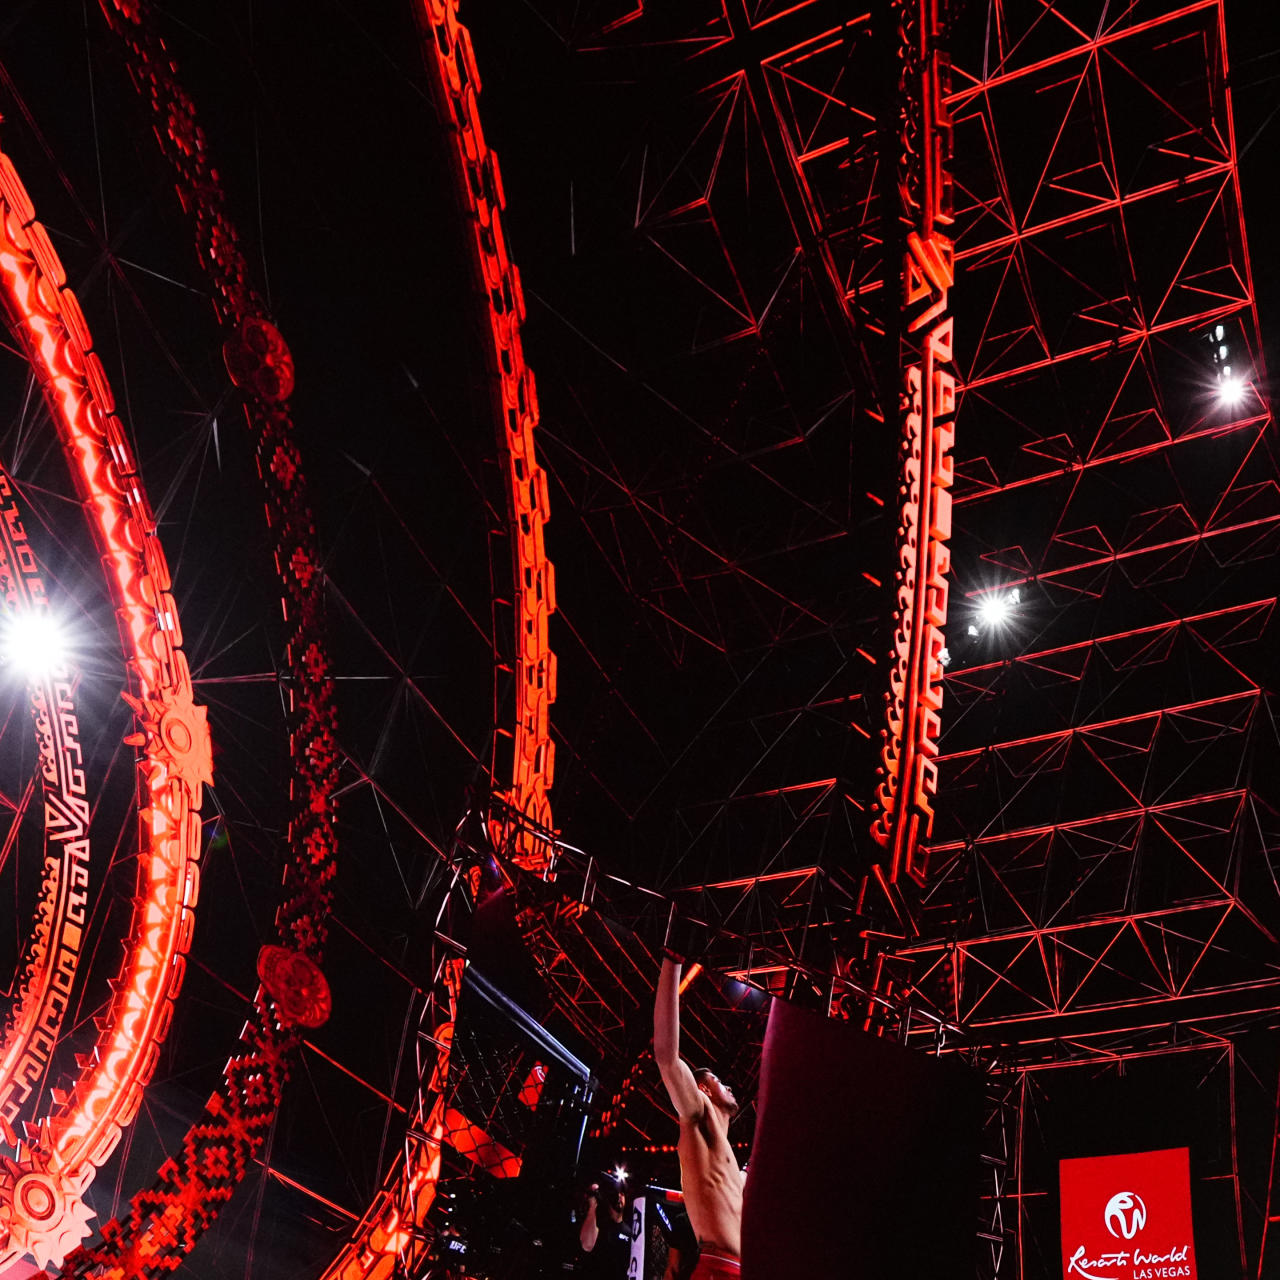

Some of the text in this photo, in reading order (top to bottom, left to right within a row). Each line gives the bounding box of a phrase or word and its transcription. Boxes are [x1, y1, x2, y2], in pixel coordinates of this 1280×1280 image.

[449, 1240, 468, 1254] UFC
[1067, 1245, 1189, 1280] Resorts World
[1133, 1265, 1191, 1280] LAS VEGAS
